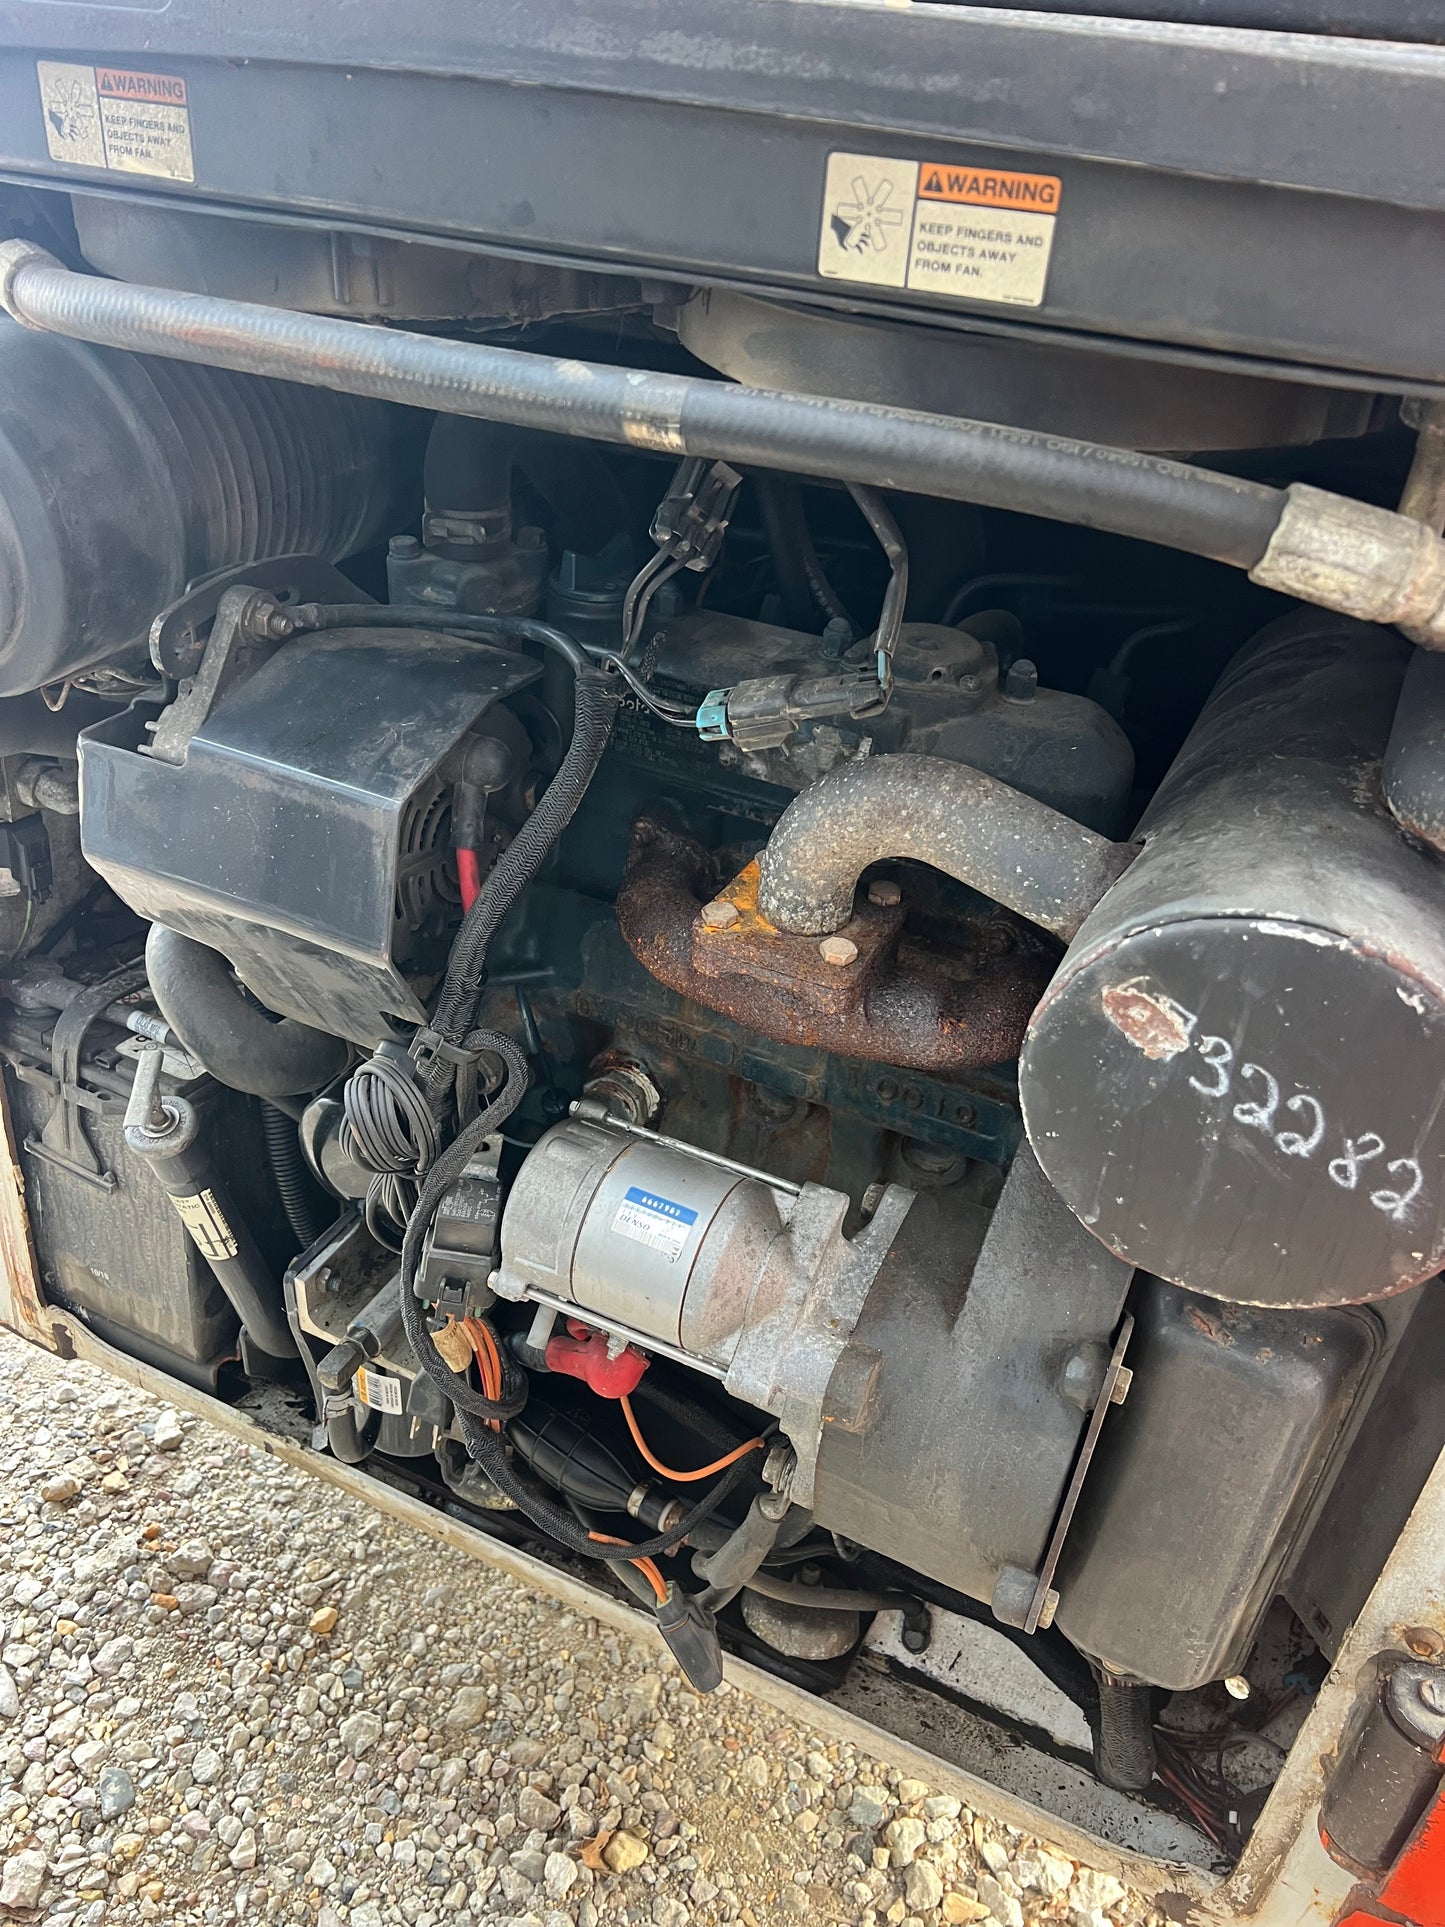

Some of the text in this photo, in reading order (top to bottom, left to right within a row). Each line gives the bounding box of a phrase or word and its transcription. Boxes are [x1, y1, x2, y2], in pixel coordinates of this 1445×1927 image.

[113, 74, 184, 98] WARNING
[104, 114, 185, 134] KEEP FINGERS AND
[107, 129, 171, 147] OBJECTS AWAY
[109, 144, 133, 156] FROM
[947, 173, 1055, 204] WARNING
[919, 223, 1044, 248] KEEP FINGERS AND
[917, 240, 1017, 263] OBJECTS AWAY
[915, 258, 984, 278] FROM FAN.
[1187, 1034, 1425, 1221] 32282
[618, 1213, 651, 1232] DENSO
